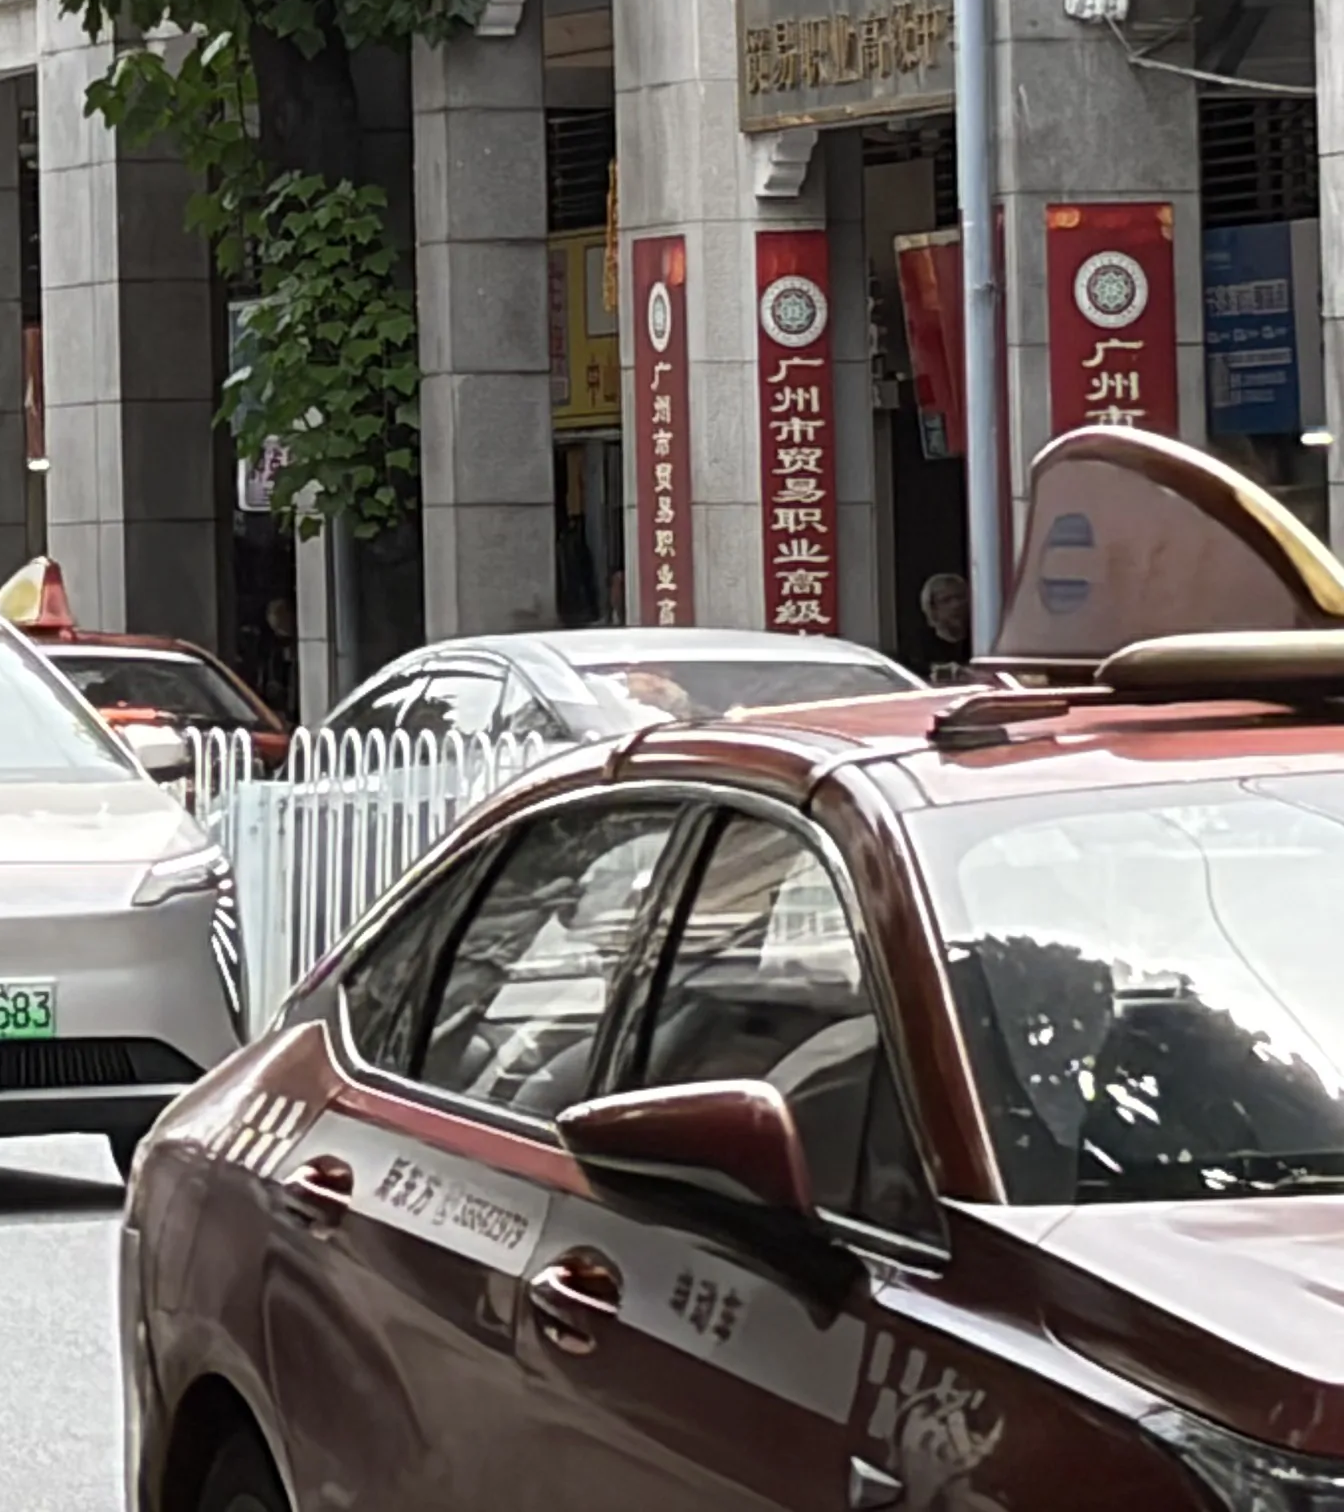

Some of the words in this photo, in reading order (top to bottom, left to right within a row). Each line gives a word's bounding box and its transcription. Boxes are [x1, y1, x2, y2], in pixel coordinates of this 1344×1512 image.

[1082, 338, 1146, 425] 广州市
[767, 356, 832, 636] 广州市贸易职业高级
